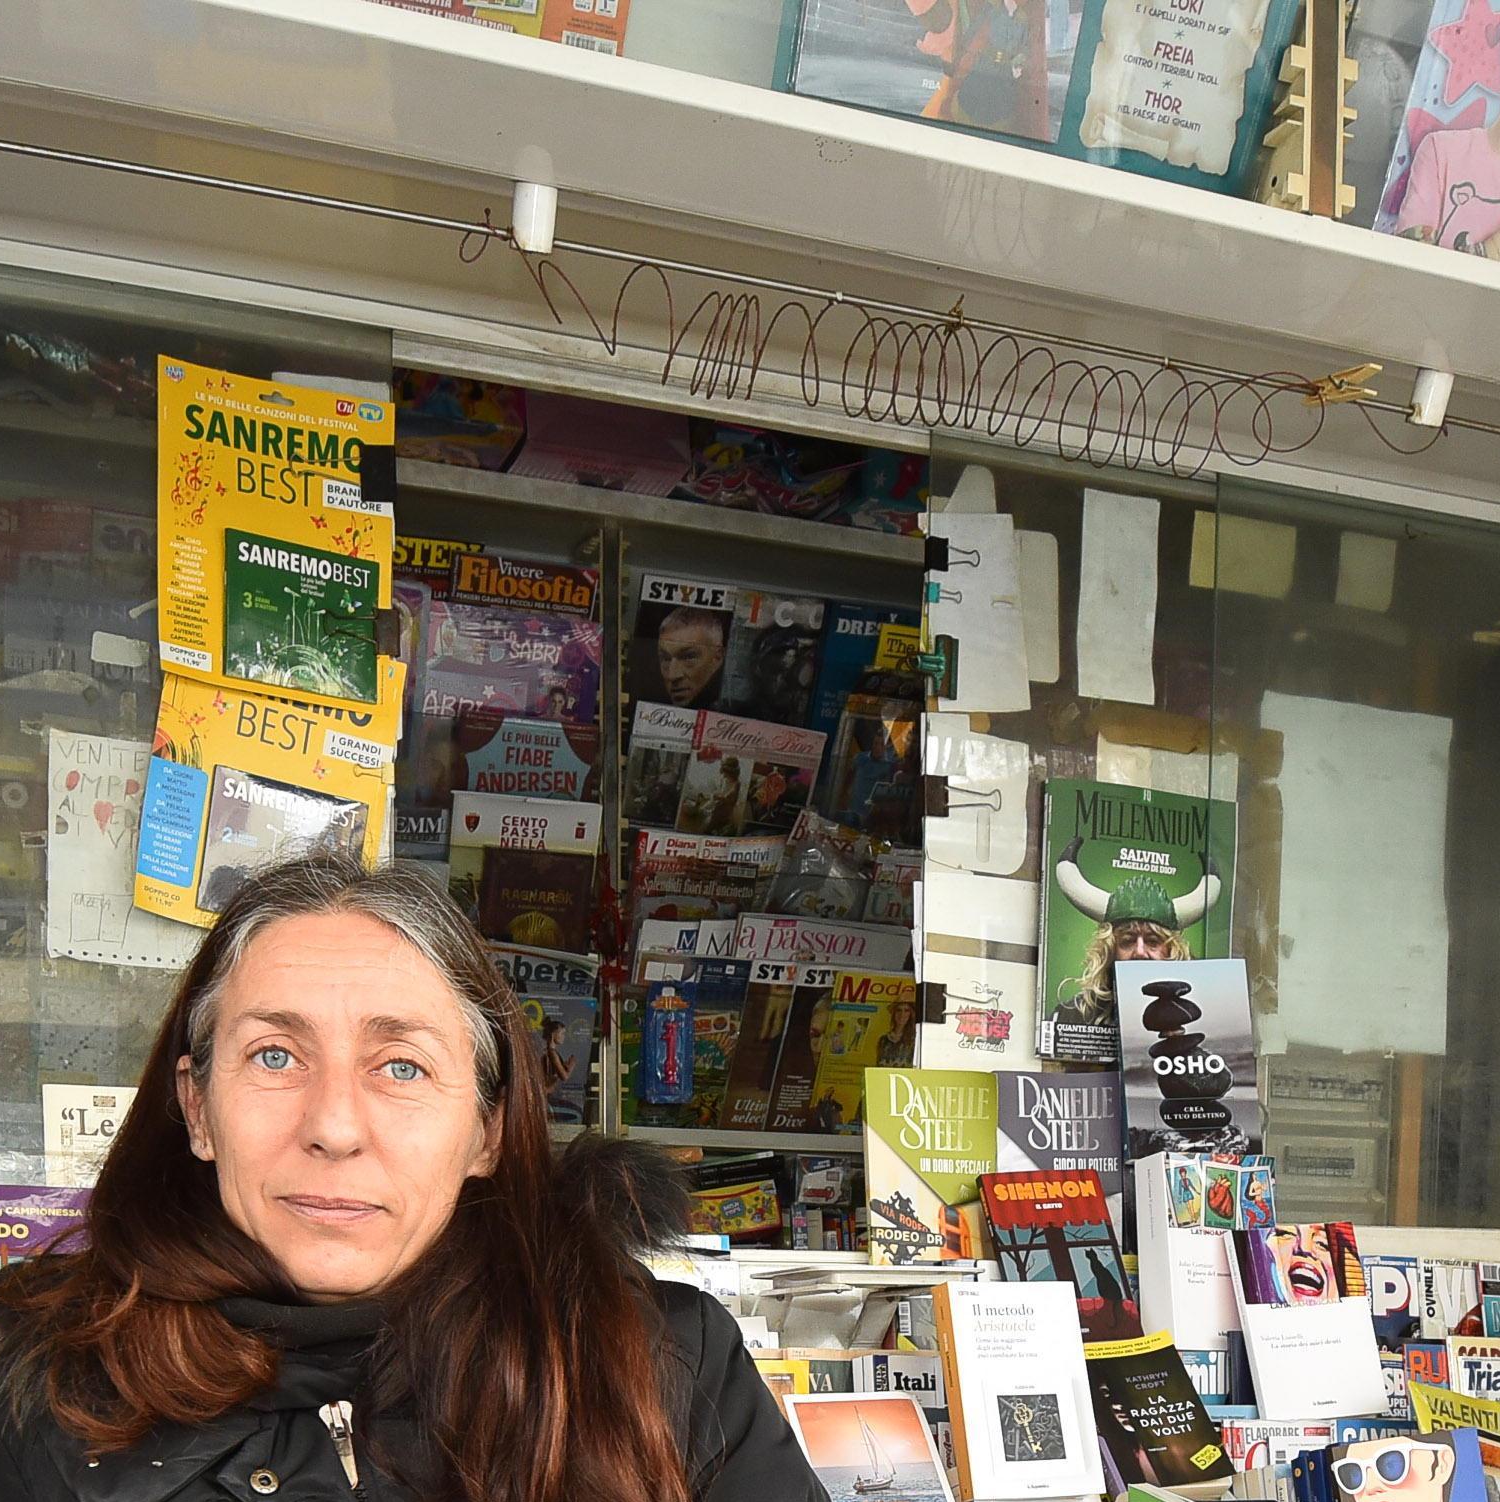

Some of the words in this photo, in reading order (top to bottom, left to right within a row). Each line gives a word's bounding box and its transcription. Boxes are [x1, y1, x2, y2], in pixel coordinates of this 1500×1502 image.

[1153, 41, 1195, 67] FREIA
[317, 416, 358, 431] FESTIVAL
[184, 405, 366, 474] SANREMO
[237, 458, 314, 506] BEST
[327, 496, 382, 512] D'AUTORE
[499, 559, 544, 579] Vivere
[459, 557, 591, 608] Filosofia
[649, 581, 725, 607] STYLE
[58, 741, 147, 770] VENITE
[330, 746, 379, 767] SUCCESSI
[505, 748, 554, 768] FIABE
[476, 773, 577, 794] ANDERSEN
[1076, 790, 1210, 852] MILLENNIUM
[1120, 848, 1169, 864] SALVINI
[764, 925, 867, 958] passion
[1154, 1055, 1225, 1075] OSHO
[889, 1074, 990, 1118] DANIELLE
[1018, 1075, 1113, 1118] DANIELLE
[1191, 1111, 1225, 1119] DESTINO
[902, 1117, 971, 1152] STEEL
[1029, 1117, 1098, 1152] STEEL
[994, 1180, 1096, 1200] SIMENON
[1130, 1403, 1195, 1420] RAGAZZA
[1152, 1424, 1194, 1437] VOLTI
